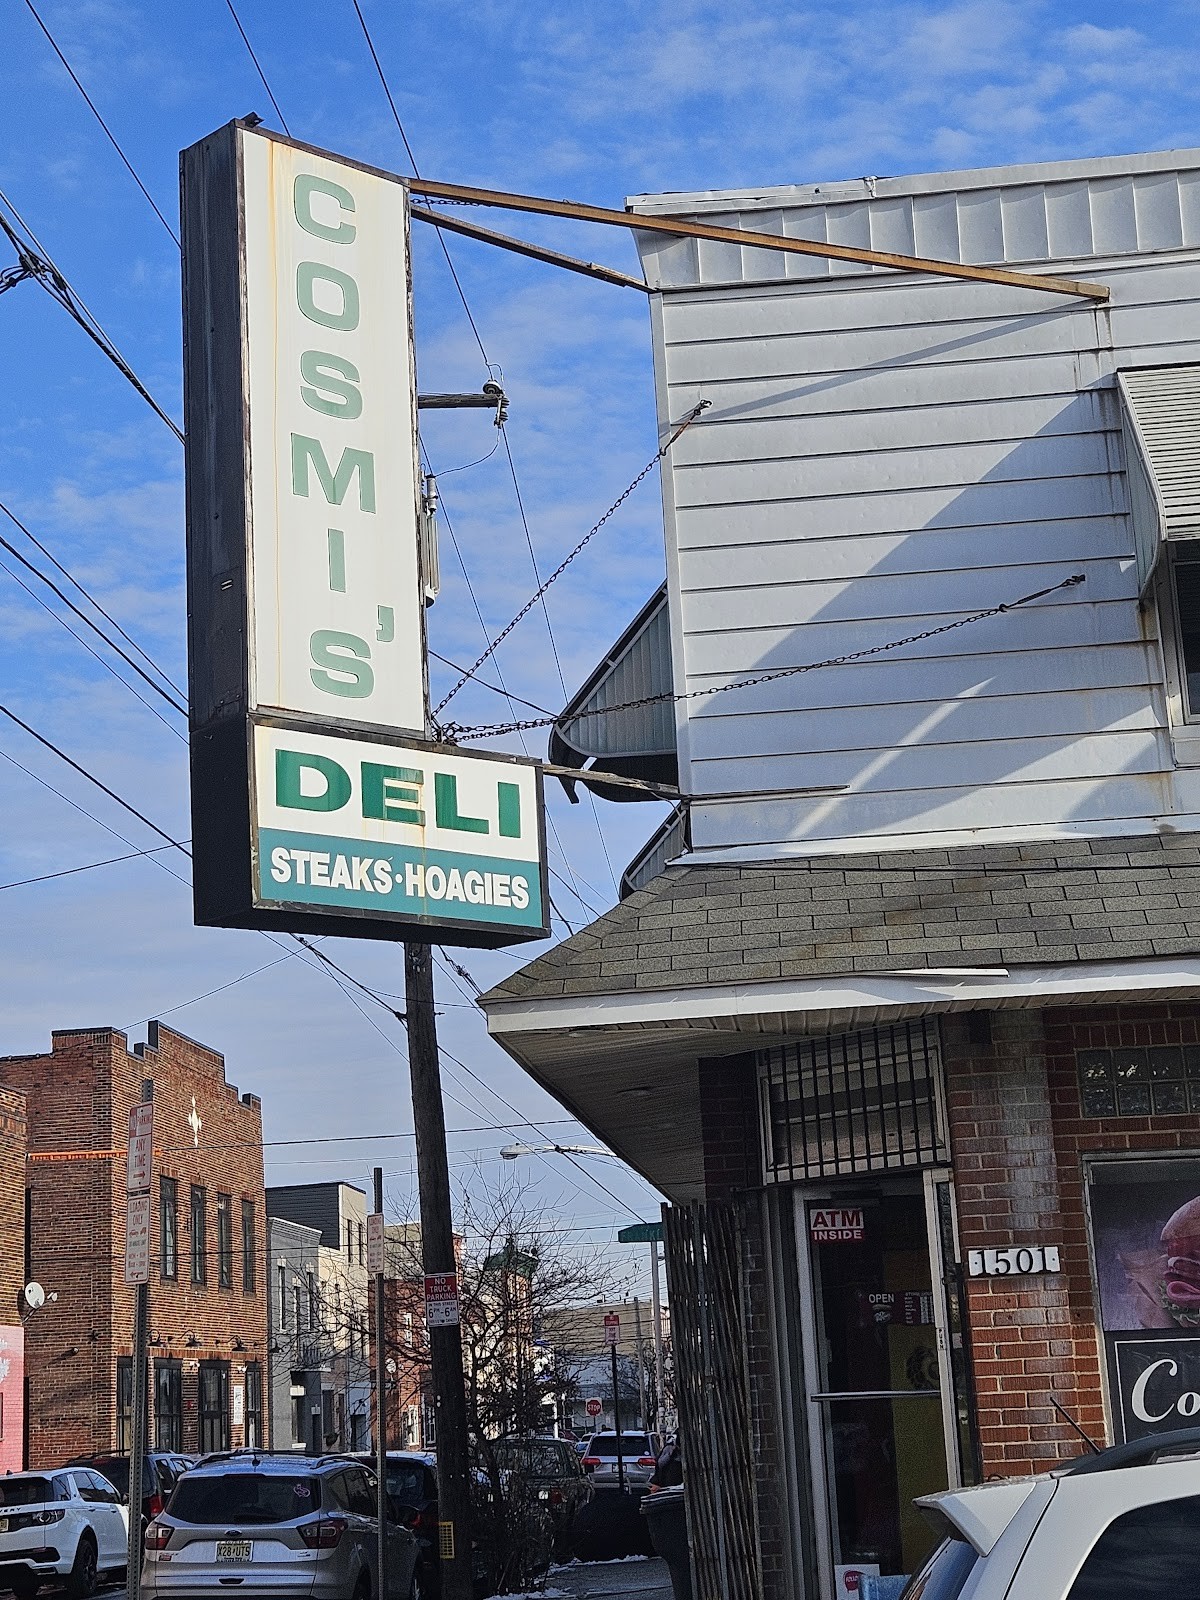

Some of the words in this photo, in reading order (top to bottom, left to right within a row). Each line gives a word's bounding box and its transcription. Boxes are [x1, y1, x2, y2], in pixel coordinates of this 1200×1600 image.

[291, 174, 394, 698] COSMI'S
[276, 749, 521, 839] DELI
[135, 1139, 145, 1151] ANY
[135, 1154, 146, 1167] TIME
[813, 1210, 860, 1228] ATM
[814, 1230, 862, 1240] INSIDE
[977, 1247, 1052, 1276] 1501
[430, 1285, 452, 1293] TRUCK
[427, 1293, 456, 1301] PARKING
[869, 1294, 894, 1303] OPEN
[1132, 1359, 1200, 1422] Co
